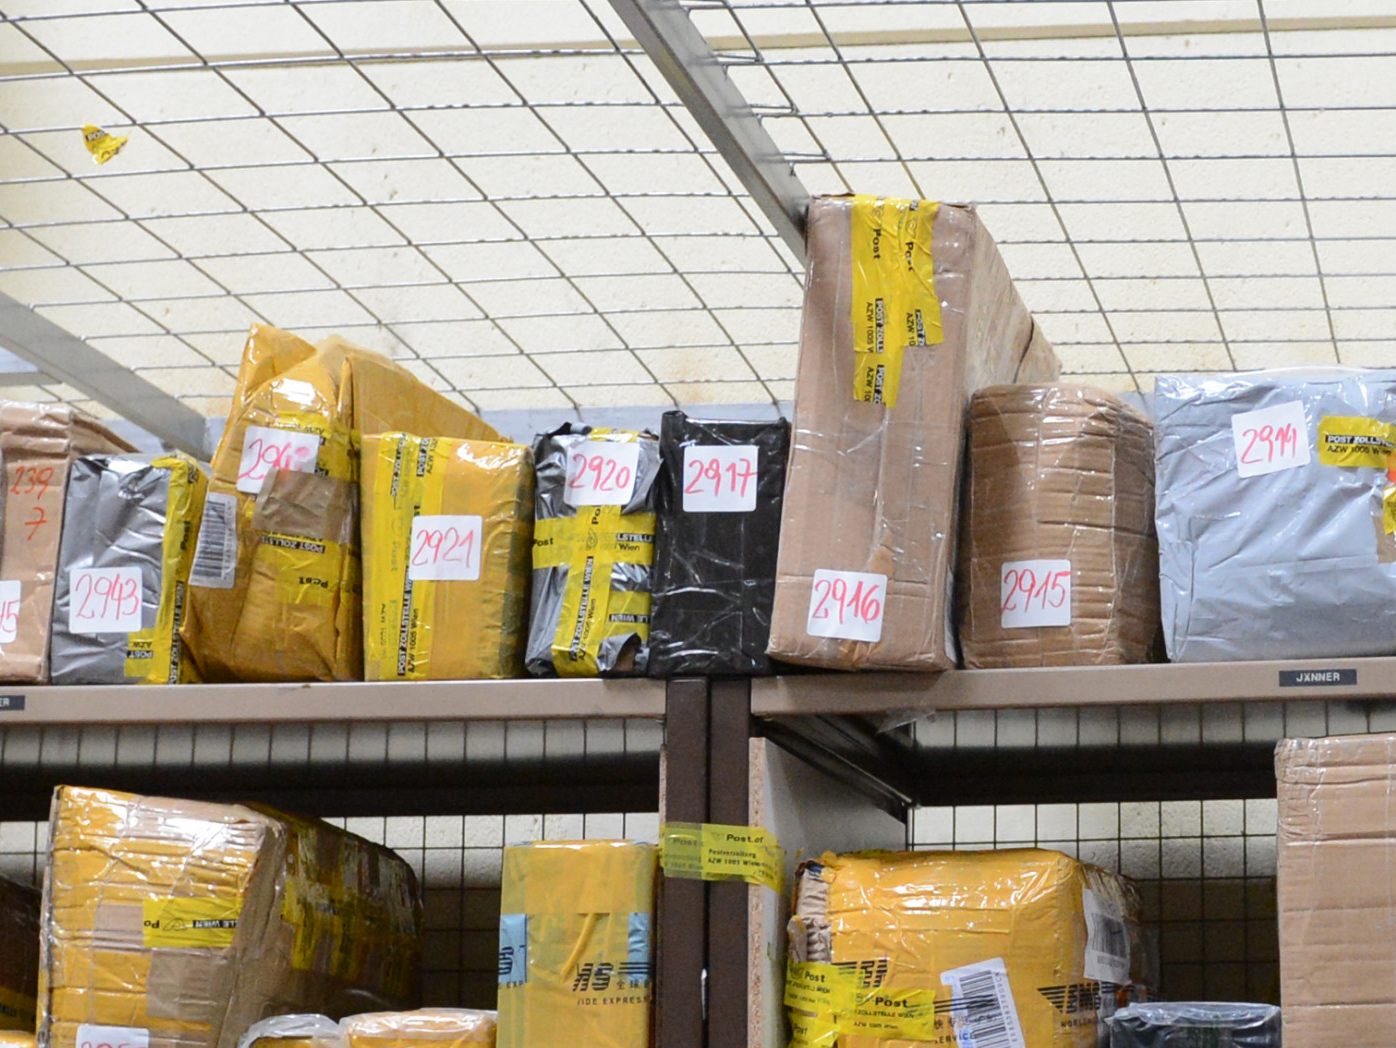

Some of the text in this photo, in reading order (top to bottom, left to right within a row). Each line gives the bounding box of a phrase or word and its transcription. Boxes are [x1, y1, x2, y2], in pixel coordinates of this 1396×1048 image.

[872, 228, 882, 259] Post
[866, 302, 874, 322] AZW
[876, 300, 884, 323] POST
[905, 312, 914, 335] AZW
[866, 367, 874, 387] AZW
[875, 367, 884, 391] POST
[1326, 445, 1348, 453] AZW
[1327, 434, 1352, 445] POST
[418, 454, 427, 475] POST
[569, 453, 631, 492] 2920
[683, 458, 759, 497] 2917
[10, 465, 54, 500] 239
[180, 520, 190, 551] Post
[411, 527, 474, 568] 2921
[74, 573, 140, 621] 2943
[573, 556, 595, 638] ZOLLSTELLE WIEN
[811, 578, 882, 625] 2916
[1002, 568, 1072, 614] 2915
[411, 607, 419, 628] Wien
[397, 593, 413, 675] POST ZOLLSTELLE
[804, 971, 827, 983] Post
[874, 996, 909, 1009] Post
